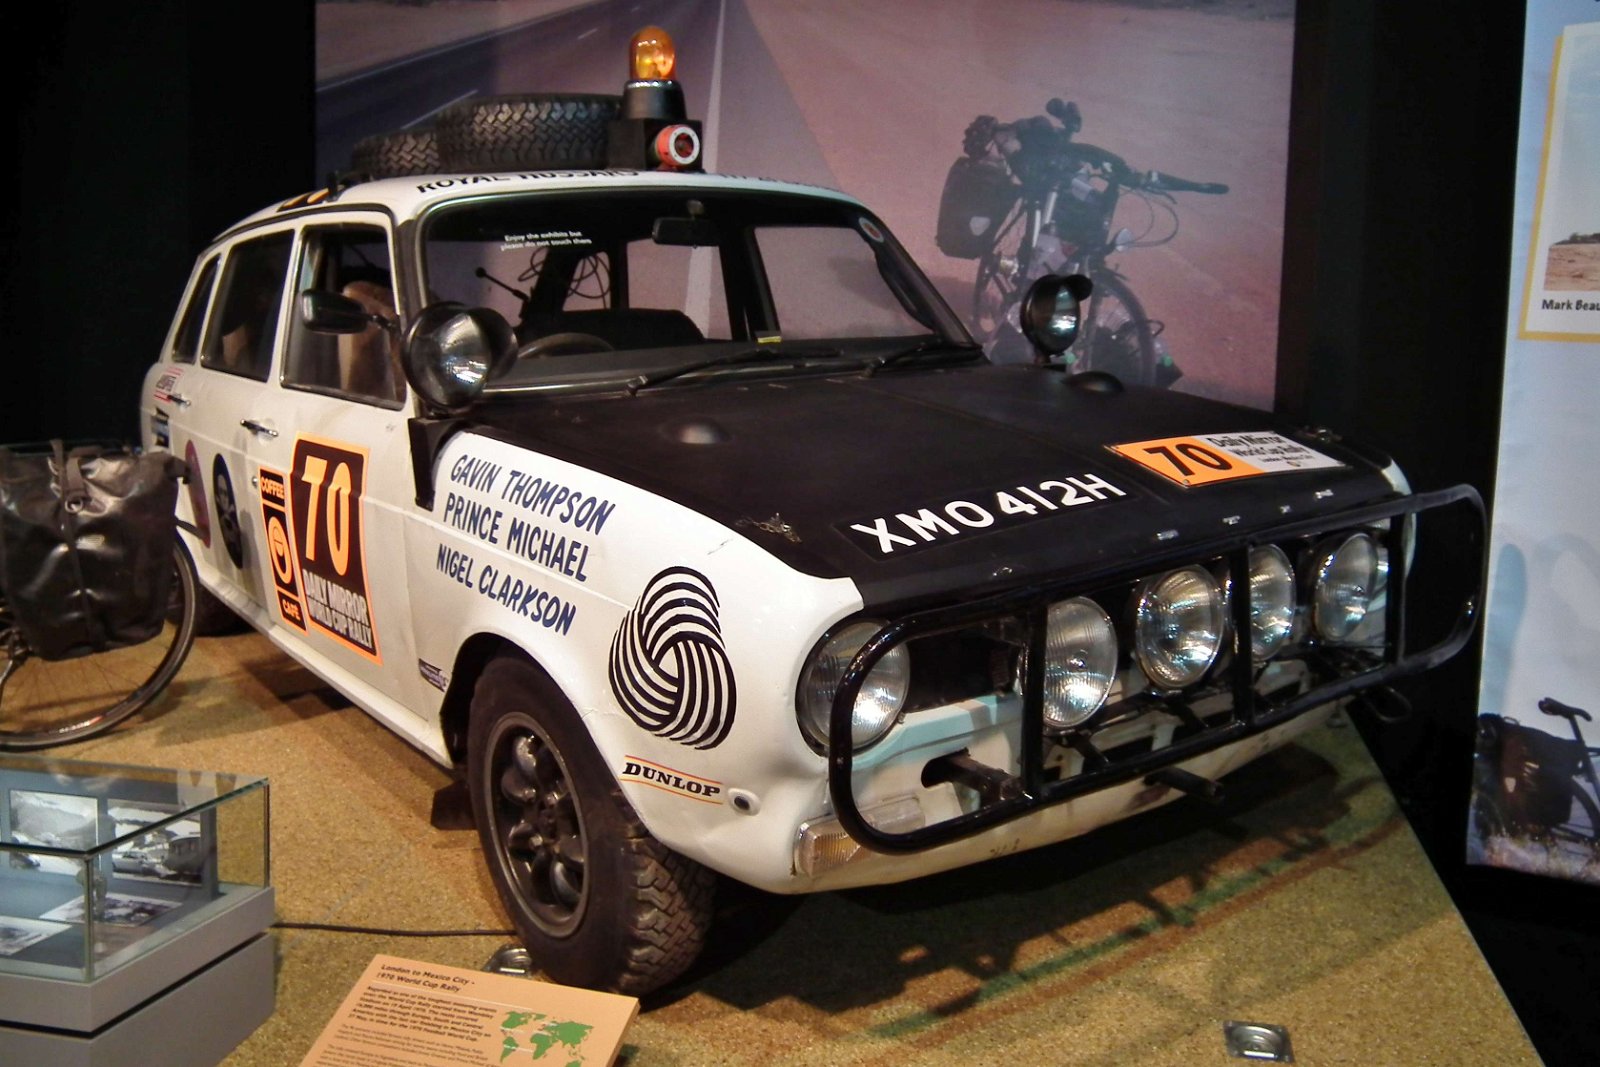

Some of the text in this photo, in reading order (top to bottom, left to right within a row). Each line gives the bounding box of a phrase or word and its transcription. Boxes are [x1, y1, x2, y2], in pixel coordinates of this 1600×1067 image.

[416, 175, 510, 193] ROYAL
[550, 238, 572, 246] touch
[1541, 299, 1573, 310] Mark
[1143, 443, 1232, 477] 70
[261, 476, 285, 499] COFFEE
[450, 454, 616, 535] GAVIN THOMPSON
[301, 455, 351, 576] 70
[850, 474, 1126, 553] XMO 412H
[443, 492, 590, 582] PRINCE MICHAEL
[302, 568, 370, 628] DAILY MIRROR
[436, 543, 577, 636] NIGEL CLARKSON
[622, 762, 721, 797] DUNLOP
[376, 972, 461, 993] 1970 World Cup Rally
[381, 964, 410, 974] London
[412, 968, 421, 976] to
[423, 971, 451, 981] Mexico
[452, 976, 470, 985] City
